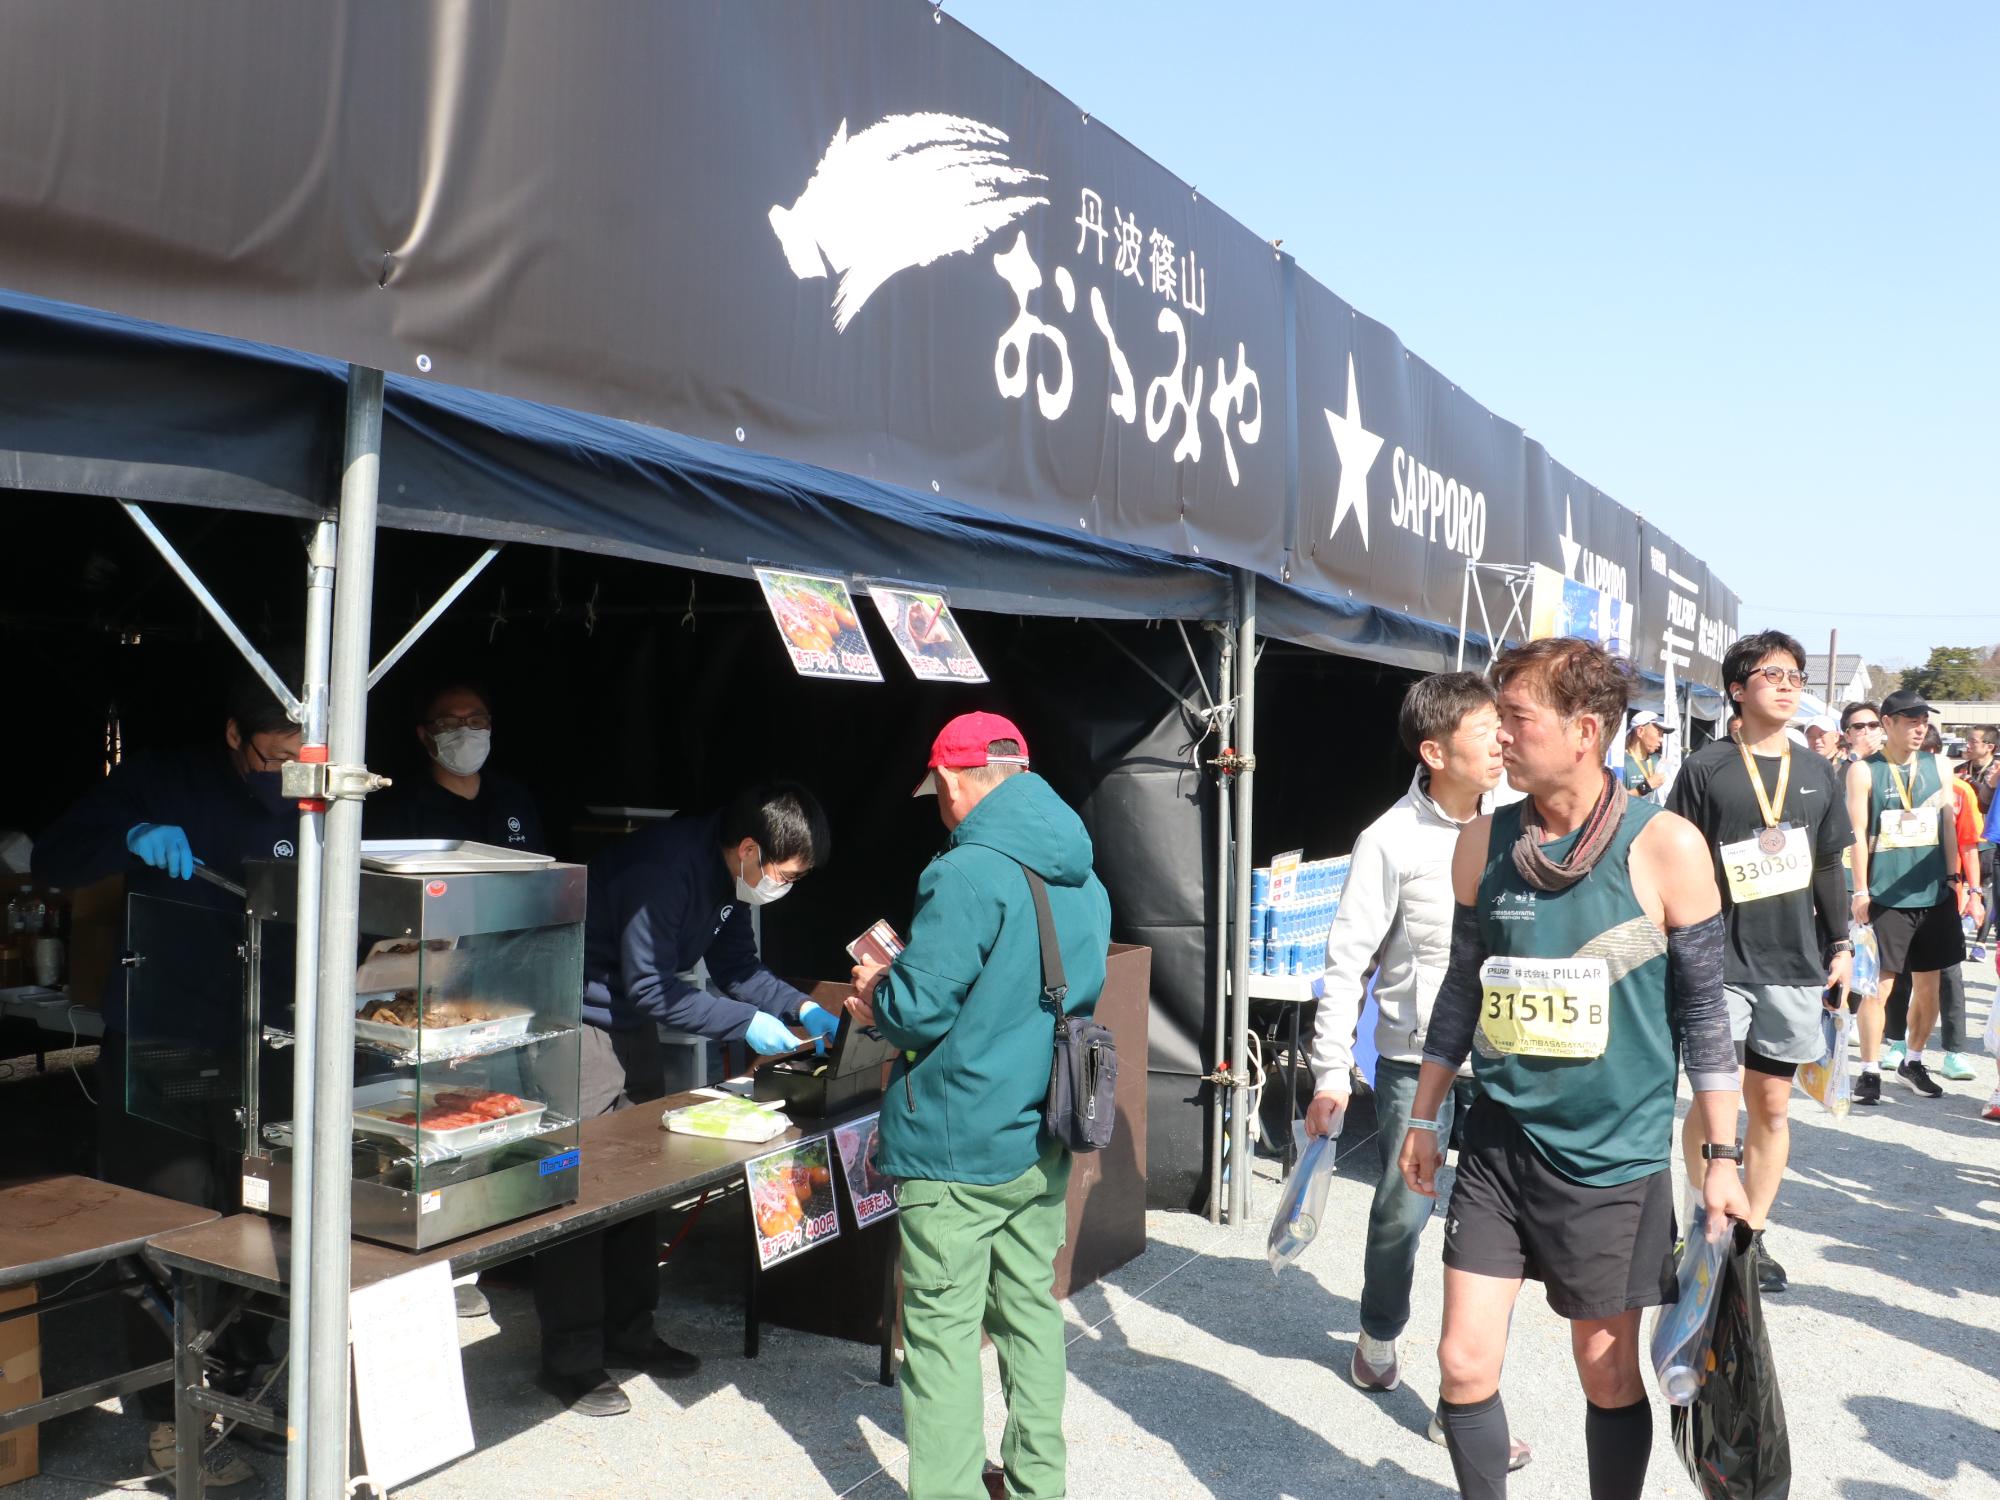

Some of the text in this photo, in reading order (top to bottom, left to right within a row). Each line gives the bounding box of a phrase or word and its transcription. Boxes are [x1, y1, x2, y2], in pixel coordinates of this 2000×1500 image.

[1074, 187, 1206, 317] 丹波篠山
[1390, 445, 1487, 562] SAPPORO
[1583, 547, 1627, 603] SAPPORO
[1733, 852, 1798, 883] 33030
[1487, 967, 1510, 976] PILLAR
[1515, 968, 1601, 980] 株式会社 PILLAR
[1488, 991, 1602, 1025] 31515 B
[806, 1212, 836, 1237] 400円
